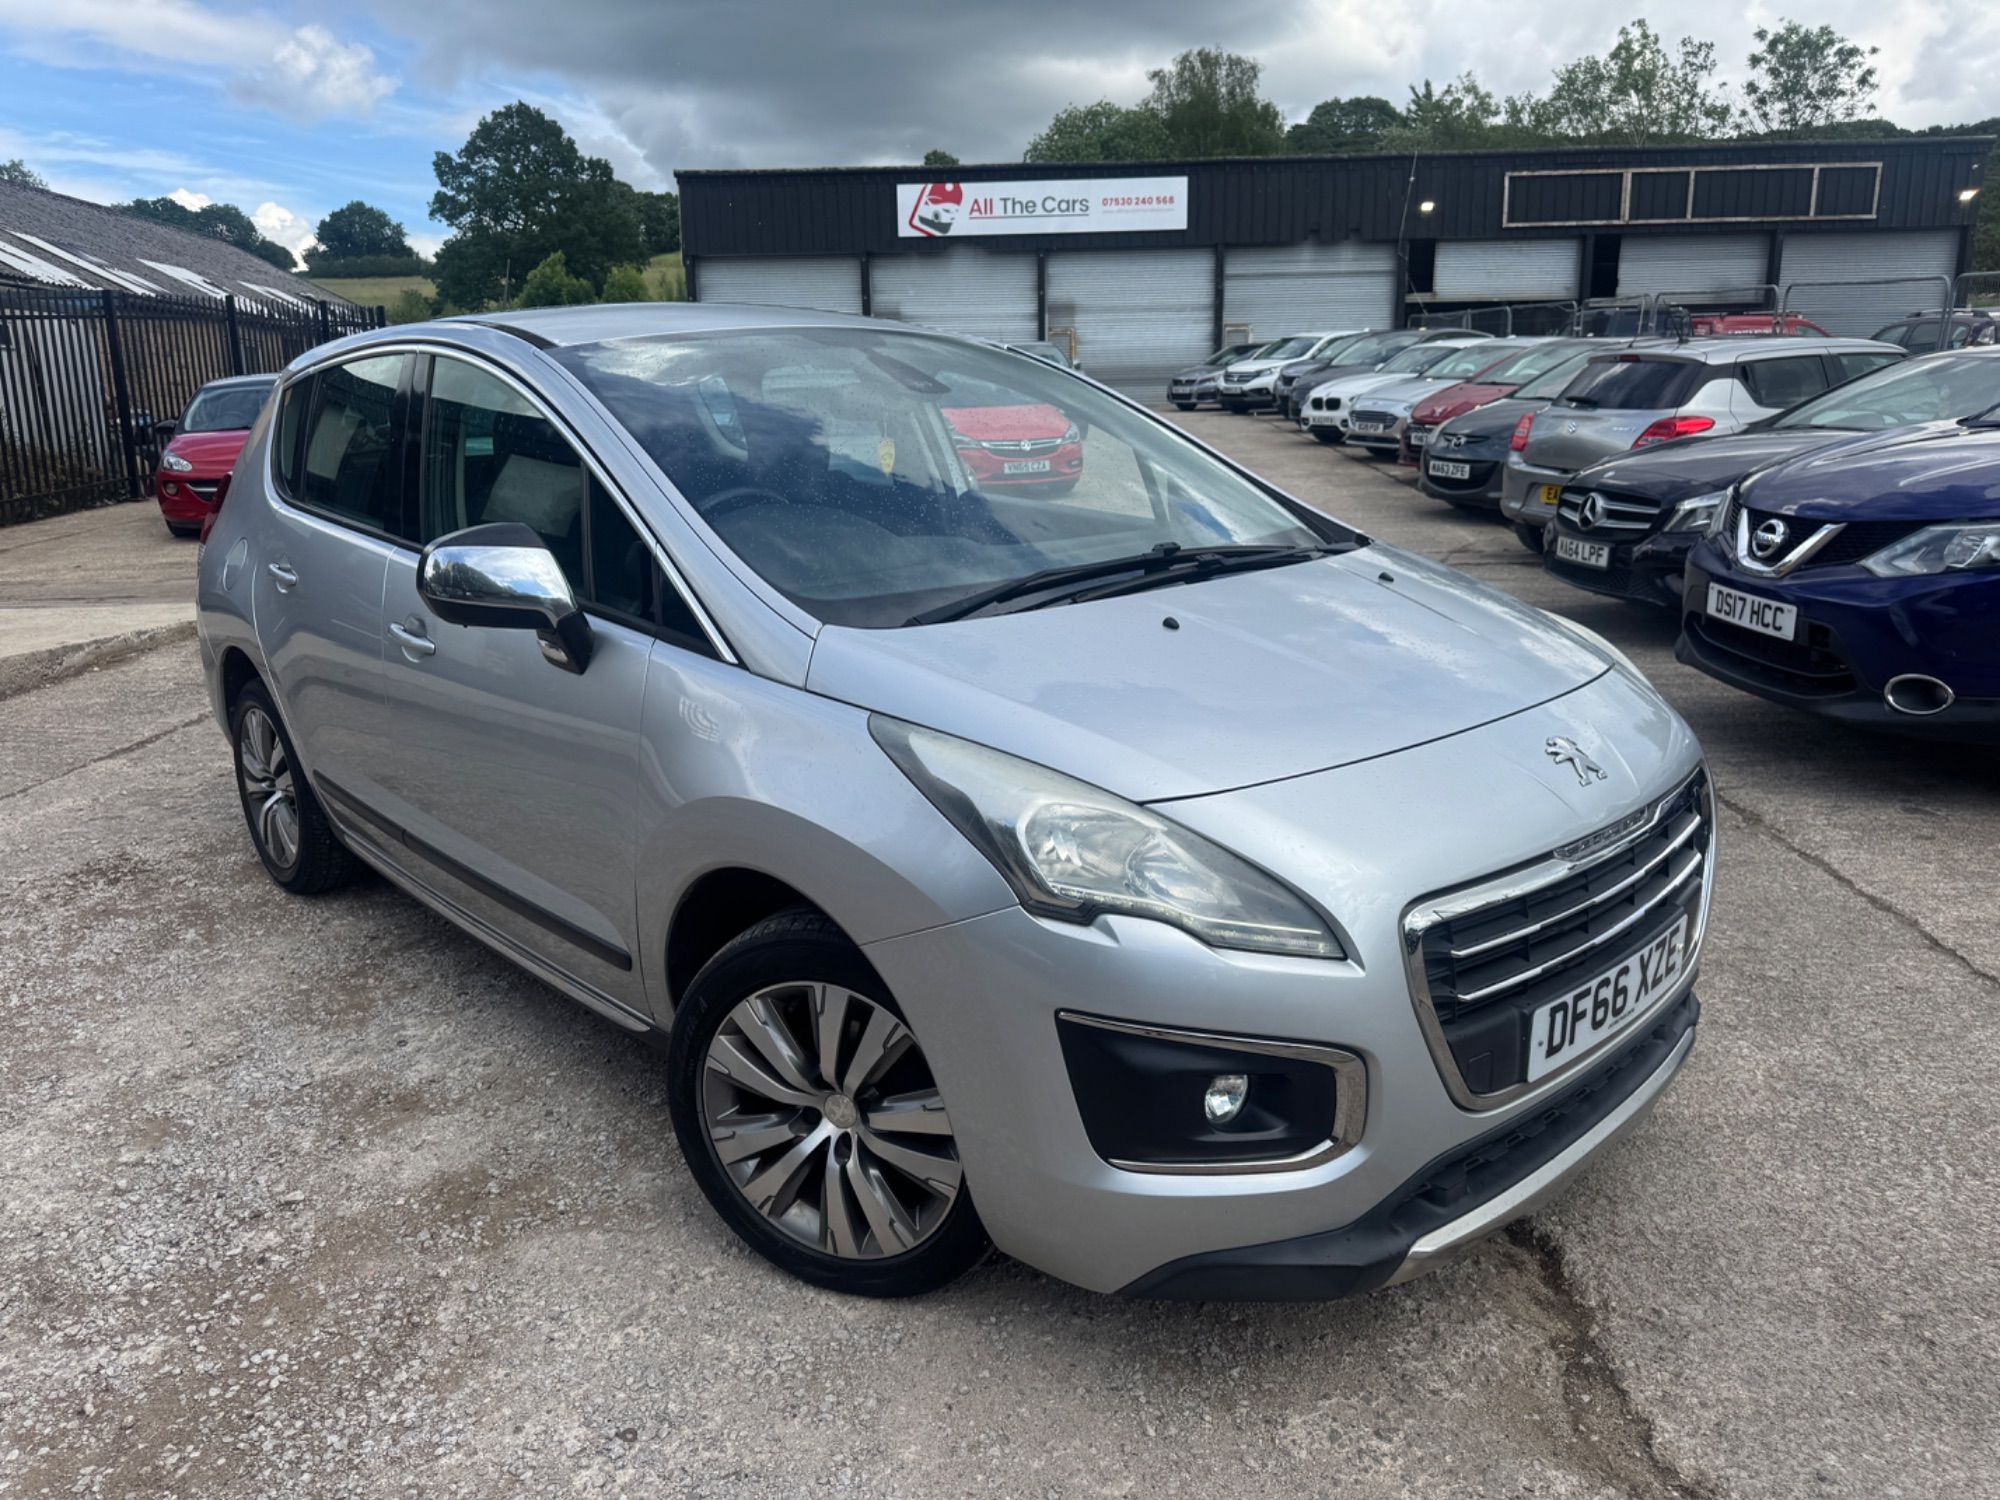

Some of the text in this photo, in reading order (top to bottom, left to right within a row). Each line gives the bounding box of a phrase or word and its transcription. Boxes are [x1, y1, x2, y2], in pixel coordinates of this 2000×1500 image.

[969, 195, 1089, 216] All The Cars
[1135, 196, 1153, 205] 240
[1581, 543, 1605, 564] LPF
[1716, 589, 1785, 631] DS17 HCC
[1546, 922, 1681, 1059] DF66 XZE
